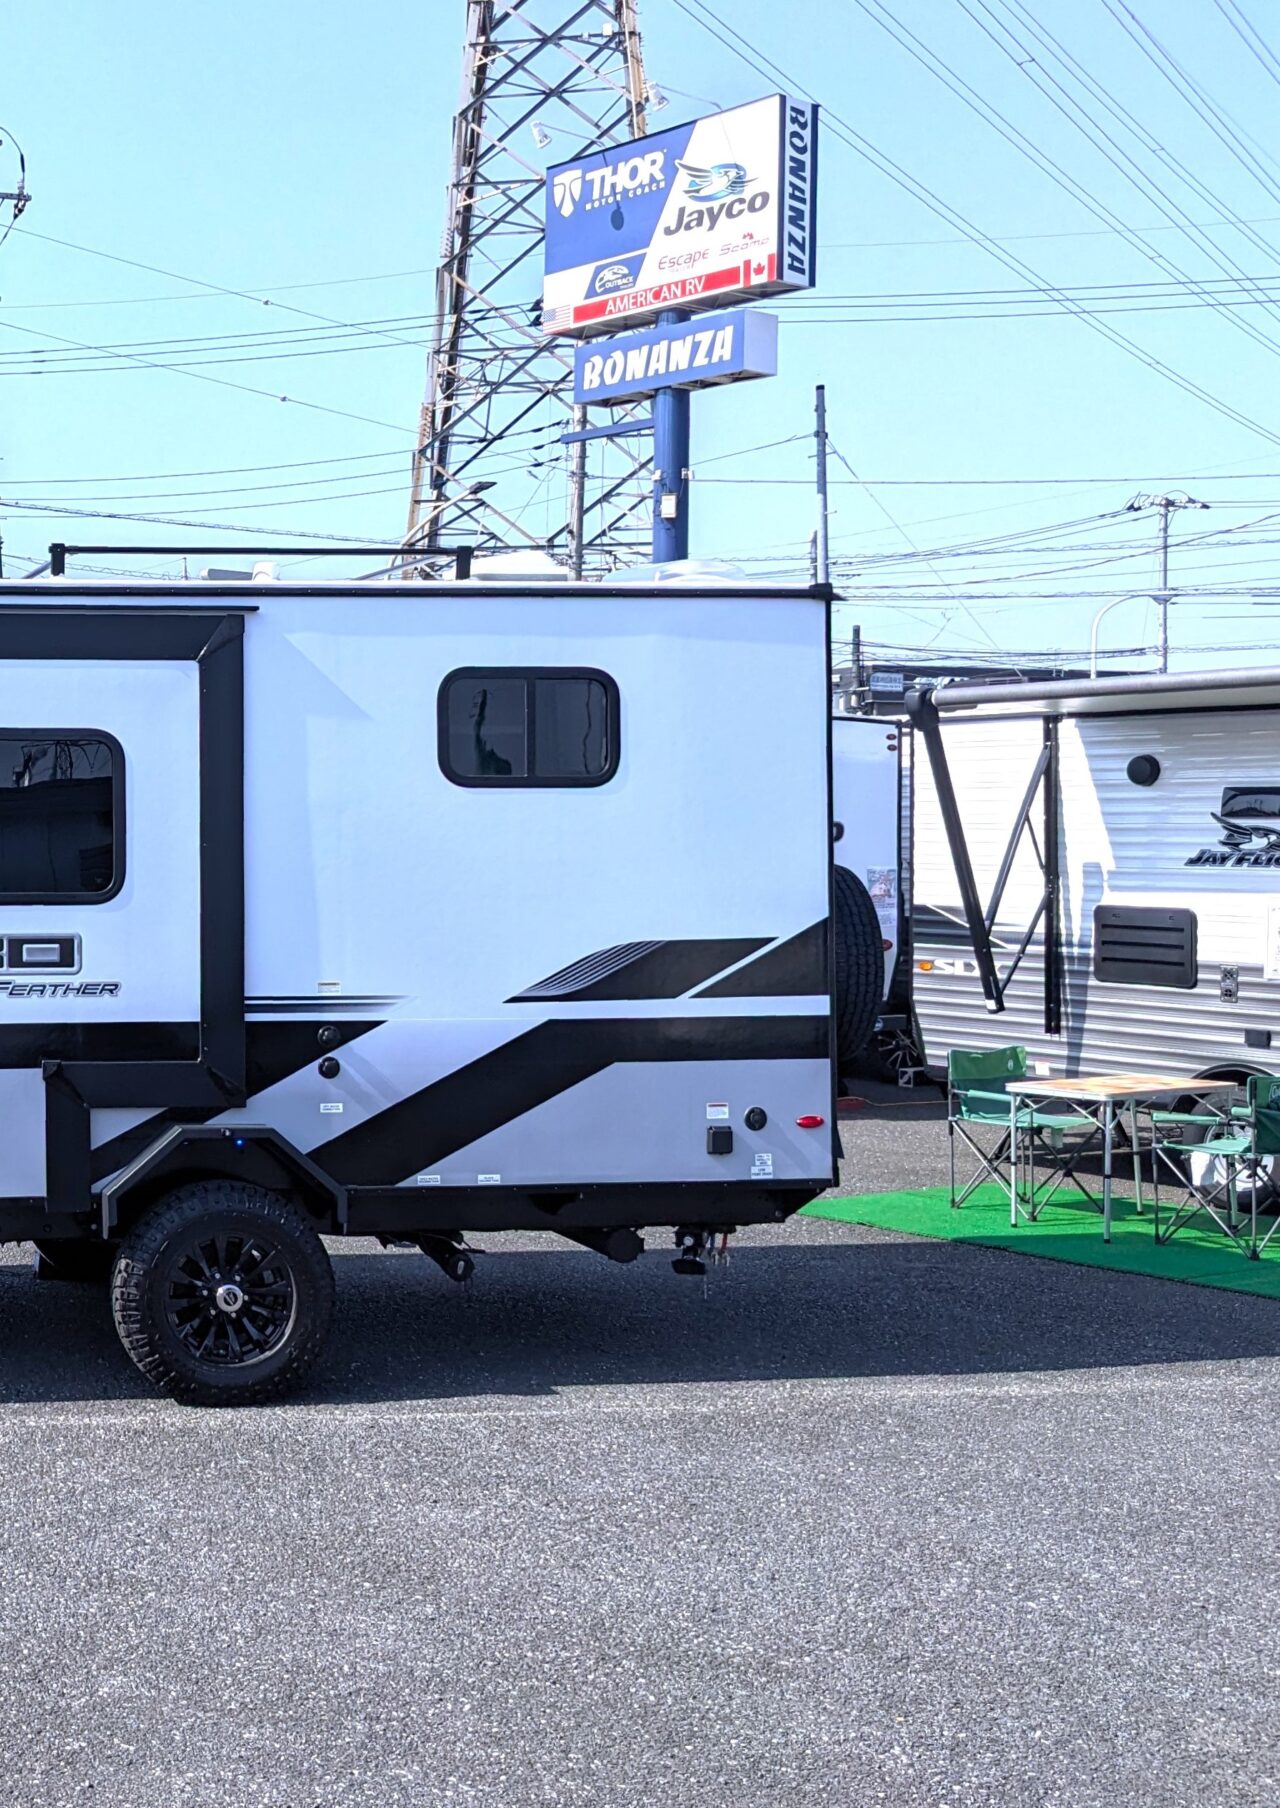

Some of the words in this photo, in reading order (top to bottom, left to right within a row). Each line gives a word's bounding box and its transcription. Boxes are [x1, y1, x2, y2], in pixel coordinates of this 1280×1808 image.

[585, 151, 665, 201] THOR
[628, 180, 666, 198] COACH
[787, 105, 809, 277] BONANZA
[663, 191, 770, 236] Jayco
[658, 248, 710, 270] Escape
[605, 279, 681, 315] AMERICAN
[685, 275, 706, 297] RV
[583, 324, 735, 391] BONANZA
[1183, 848, 1235, 867] JAY
